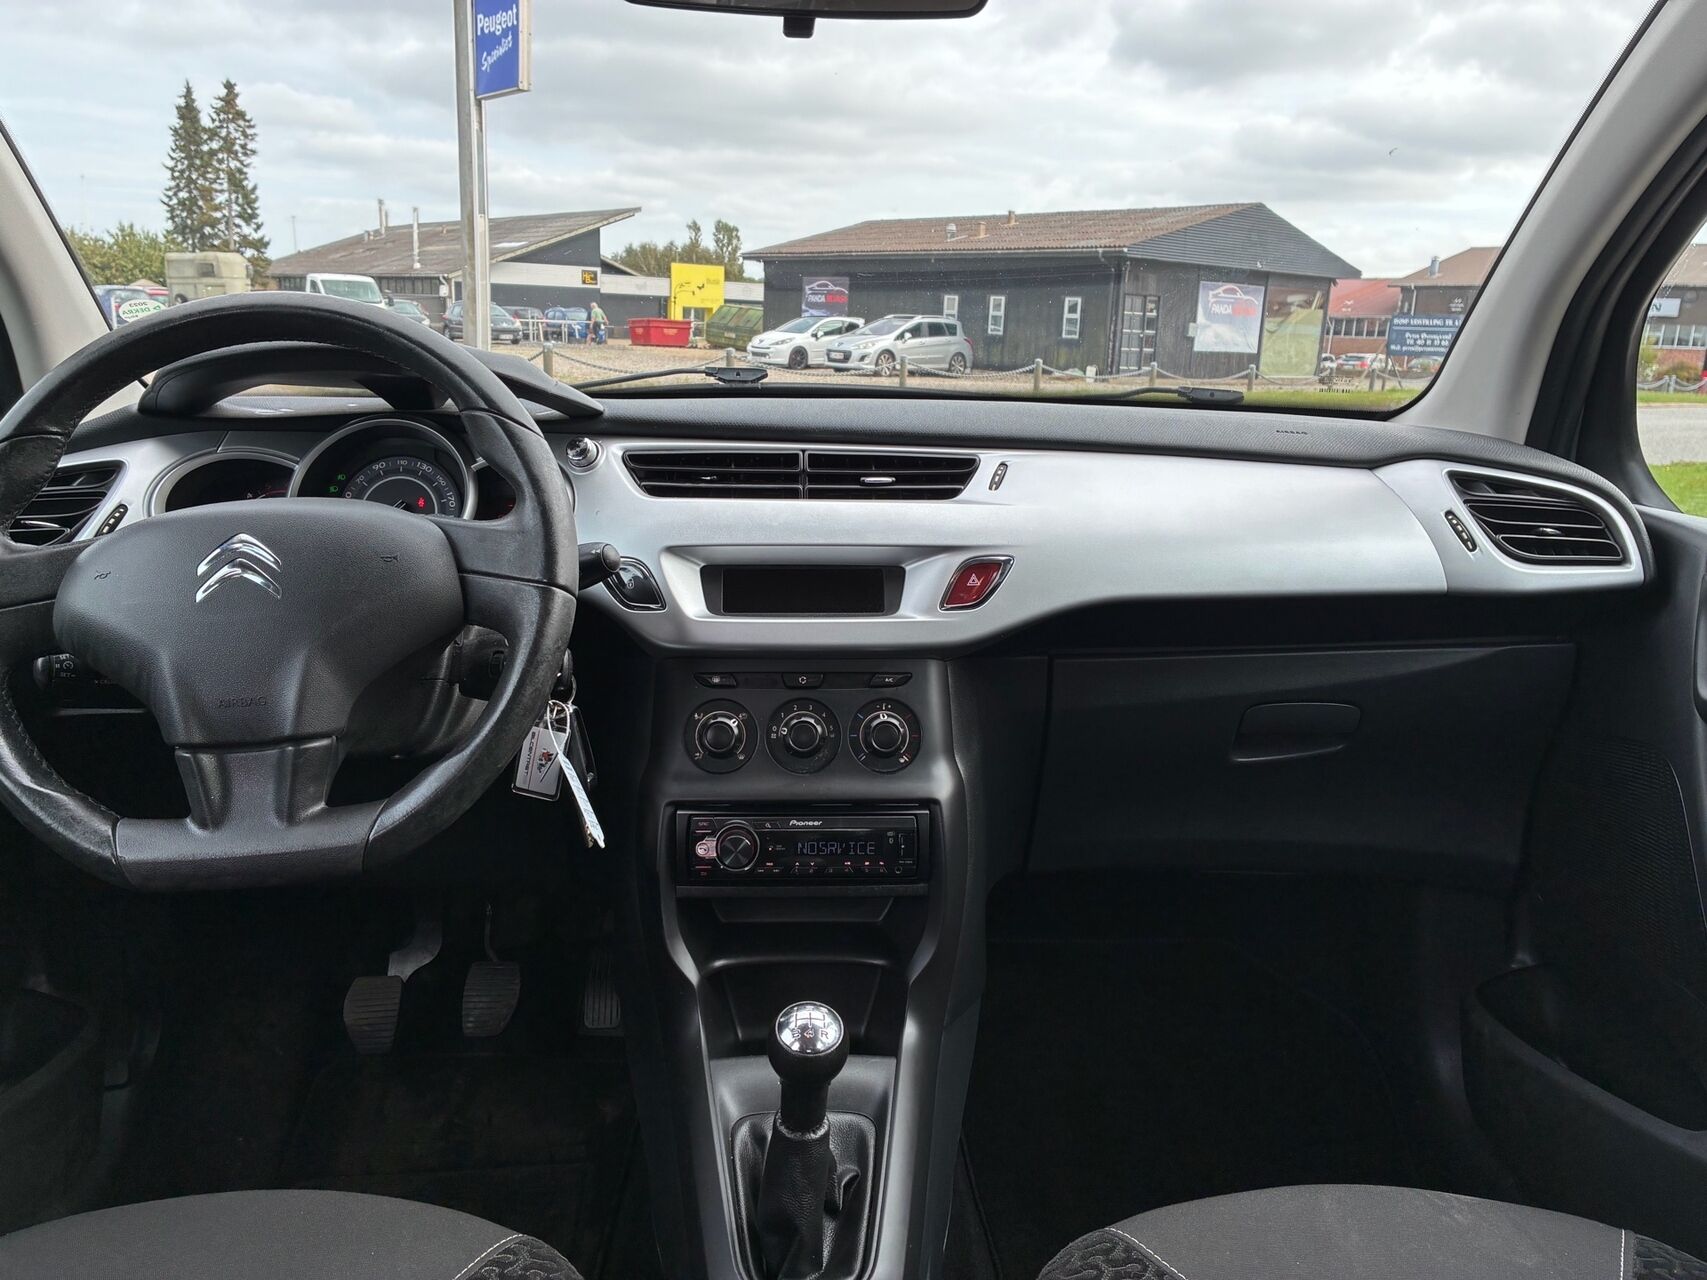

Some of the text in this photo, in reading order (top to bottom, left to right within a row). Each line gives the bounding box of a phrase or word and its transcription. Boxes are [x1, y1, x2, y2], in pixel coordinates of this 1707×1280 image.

[477, 4, 517, 36] Peugeot
[372, 461, 386, 471] 90
[416, 461, 433, 473] 130
[446, 491, 456, 508] 170
[789, 819, 823, 827] Pioneer
[820, 1030, 829, 1040] R
